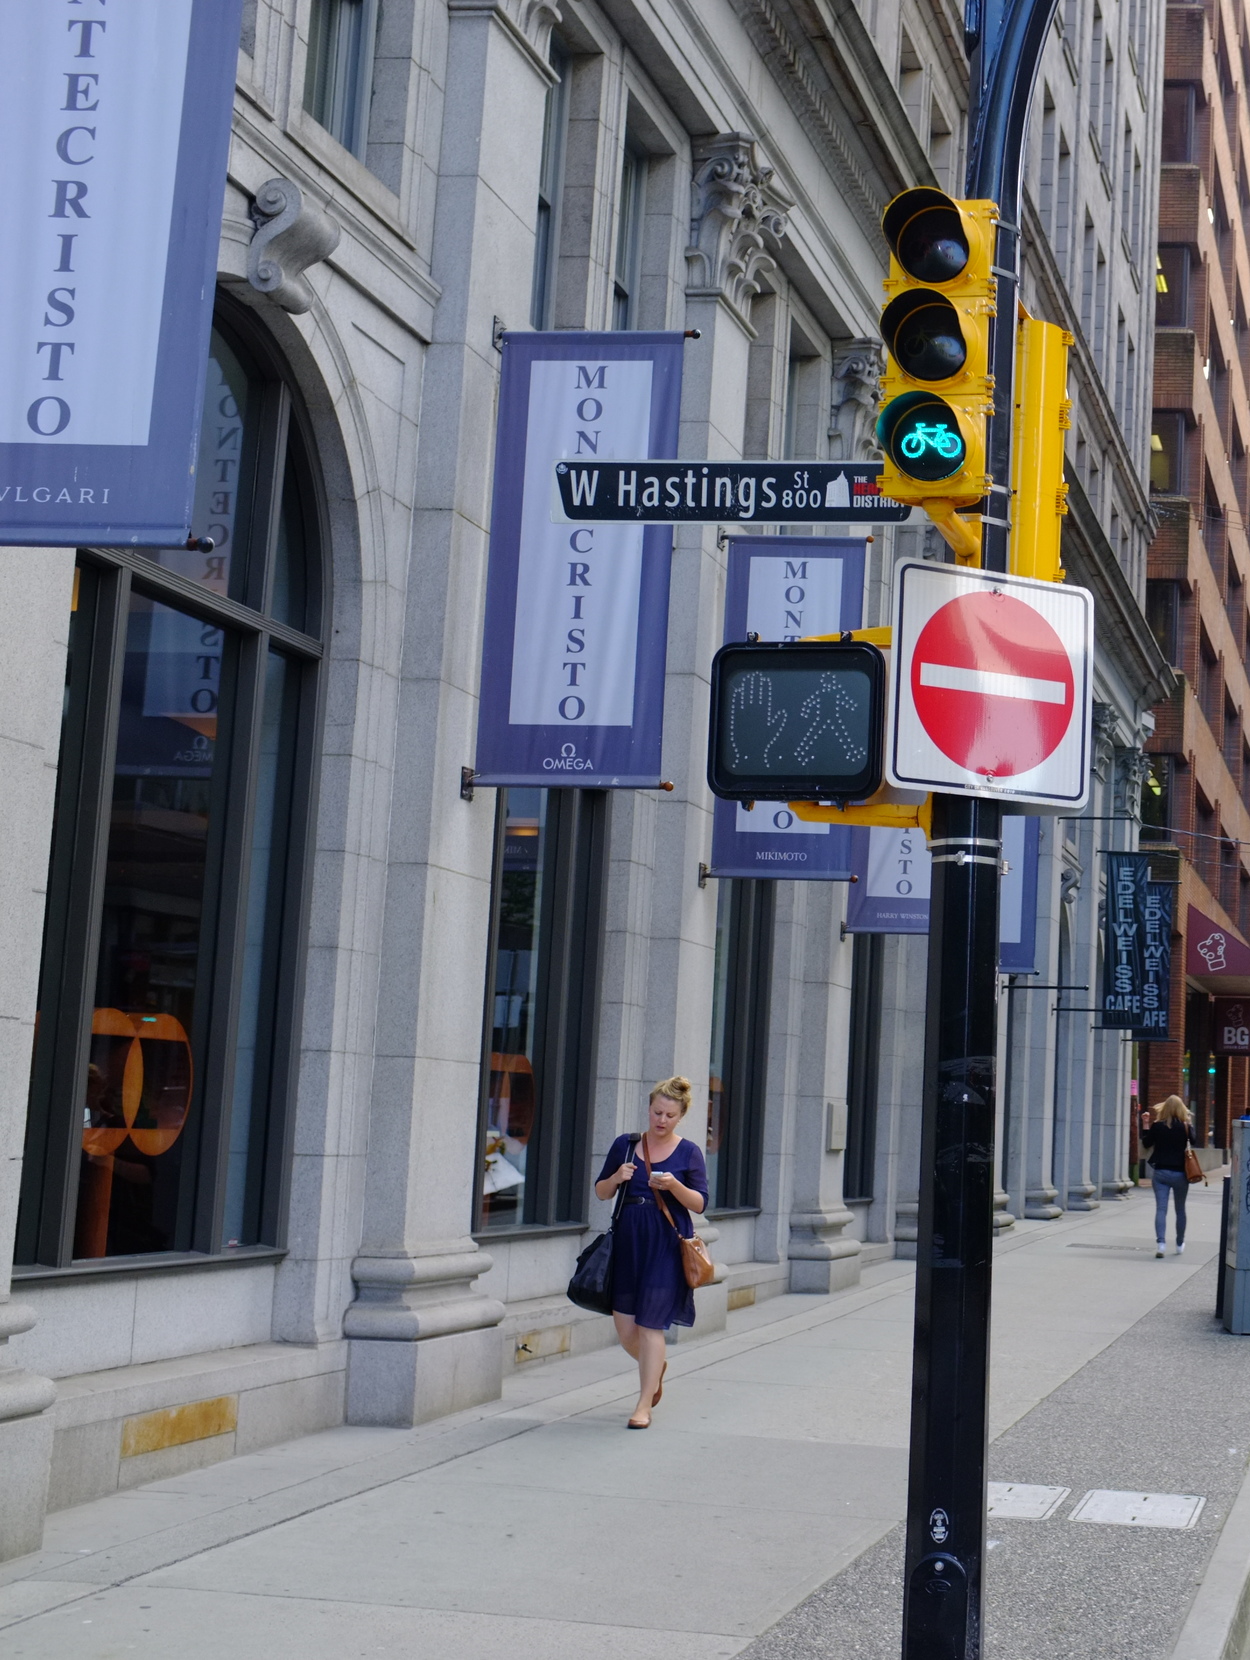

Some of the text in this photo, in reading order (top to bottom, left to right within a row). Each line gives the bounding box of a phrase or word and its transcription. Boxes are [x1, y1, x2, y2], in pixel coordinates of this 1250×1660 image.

[27, 0, 107, 436] TECRISTO
[793, 471, 809, 488] St
[570, 467, 777, 518] W Hastings
[782, 490, 821, 508] 800
[853, 495, 905, 508] DISTRI
[558, 365, 608, 720] MONCRISTO
[542, 757, 593, 770] OMEGA
[755, 852, 807, 862] MIKIMOTO
[1112, 867, 1138, 993] EDELWEISS
[1143, 895, 1165, 1009] EDELWEISS
[1105, 994, 1140, 1014] CAFE
[1143, 1010, 1166, 1027] AFE
[1223, 1026, 1249, 1045] BG
